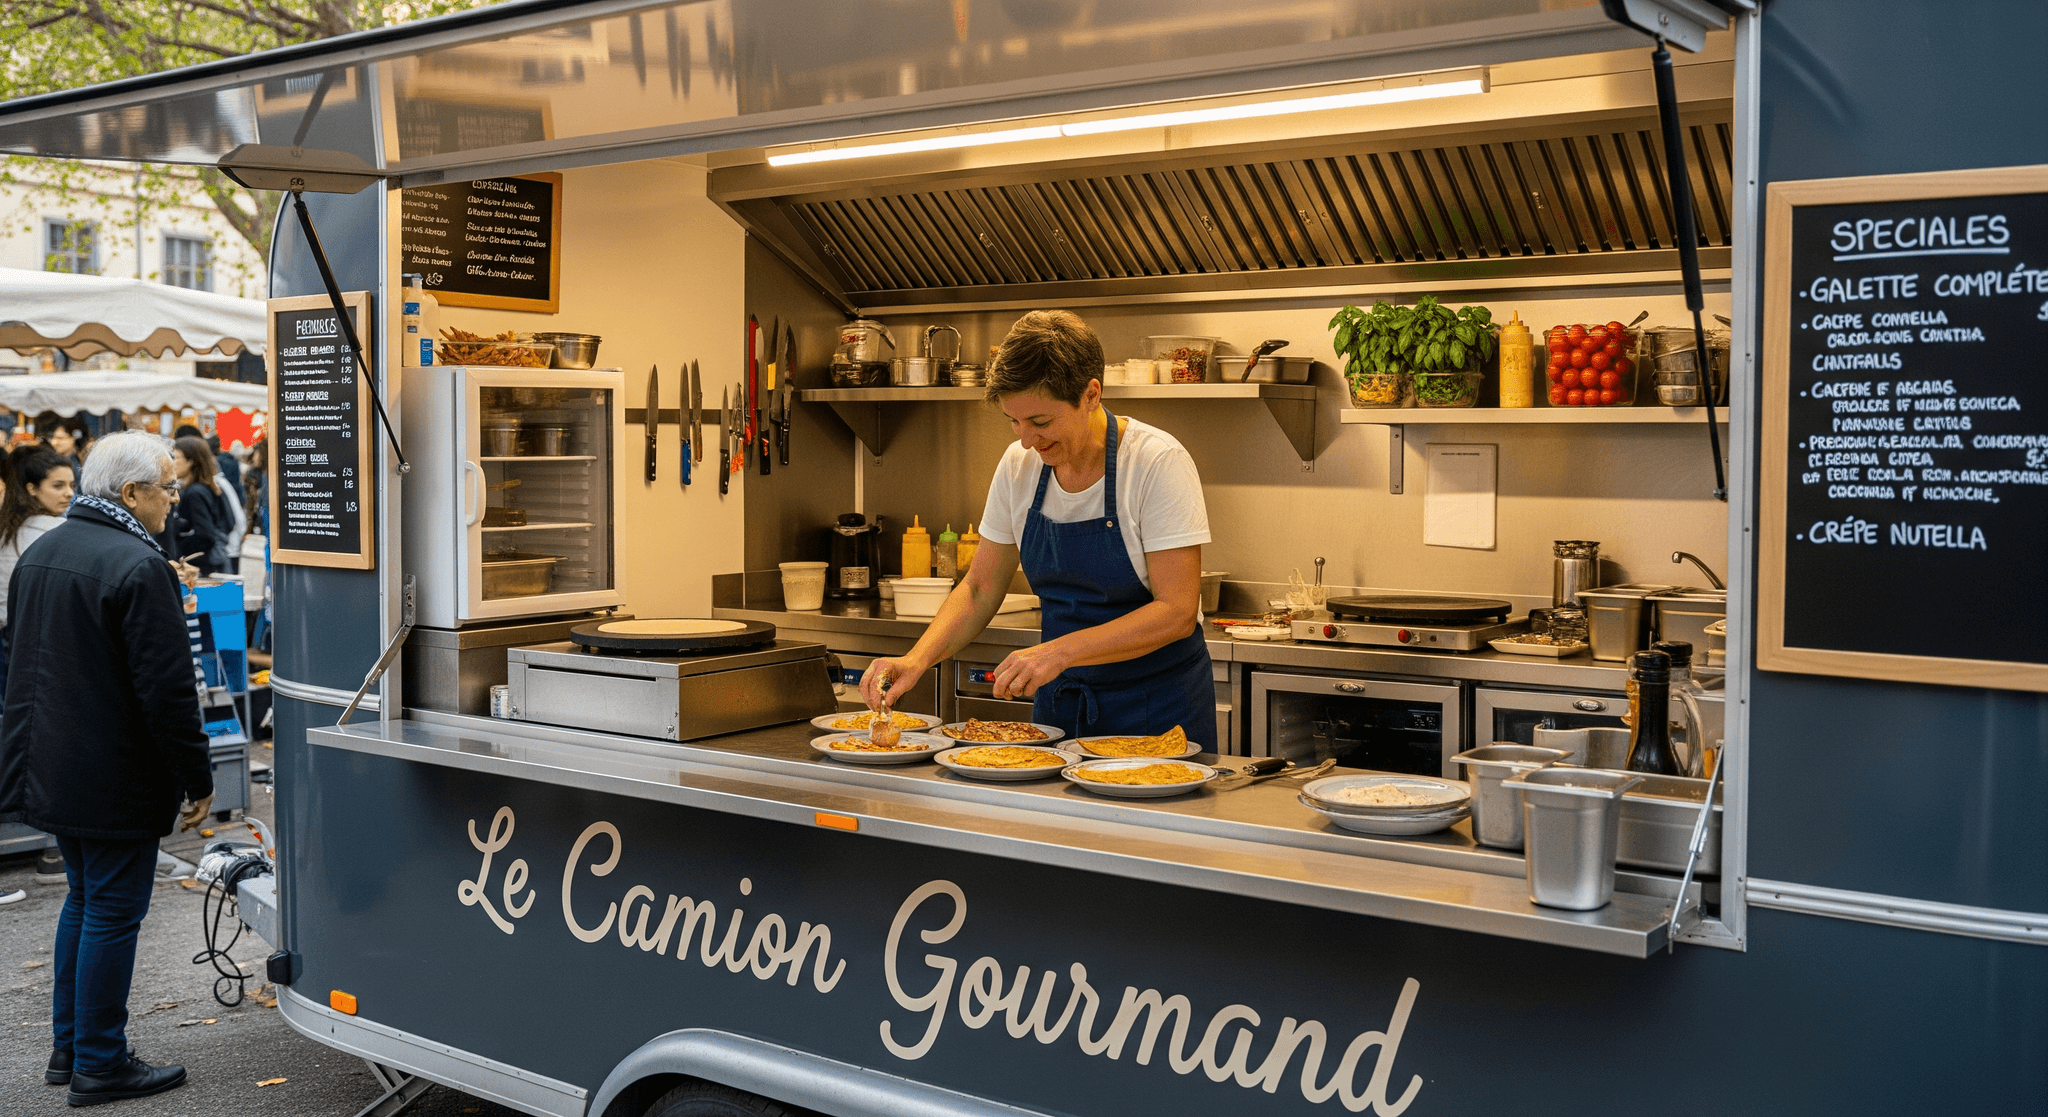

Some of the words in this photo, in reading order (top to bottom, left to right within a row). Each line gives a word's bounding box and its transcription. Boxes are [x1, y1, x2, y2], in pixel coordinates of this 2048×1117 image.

[1831, 215, 2010, 252] SPECIALES
[1810, 273, 1919, 303] GALETTE
[1809, 515, 1878, 544] CRÉPE
[1890, 521, 1987, 550] NUTELLA
[457, 806, 535, 935] Le
[561, 820, 847, 994] Camion
[879, 879, 1424, 1117] Gourmand
